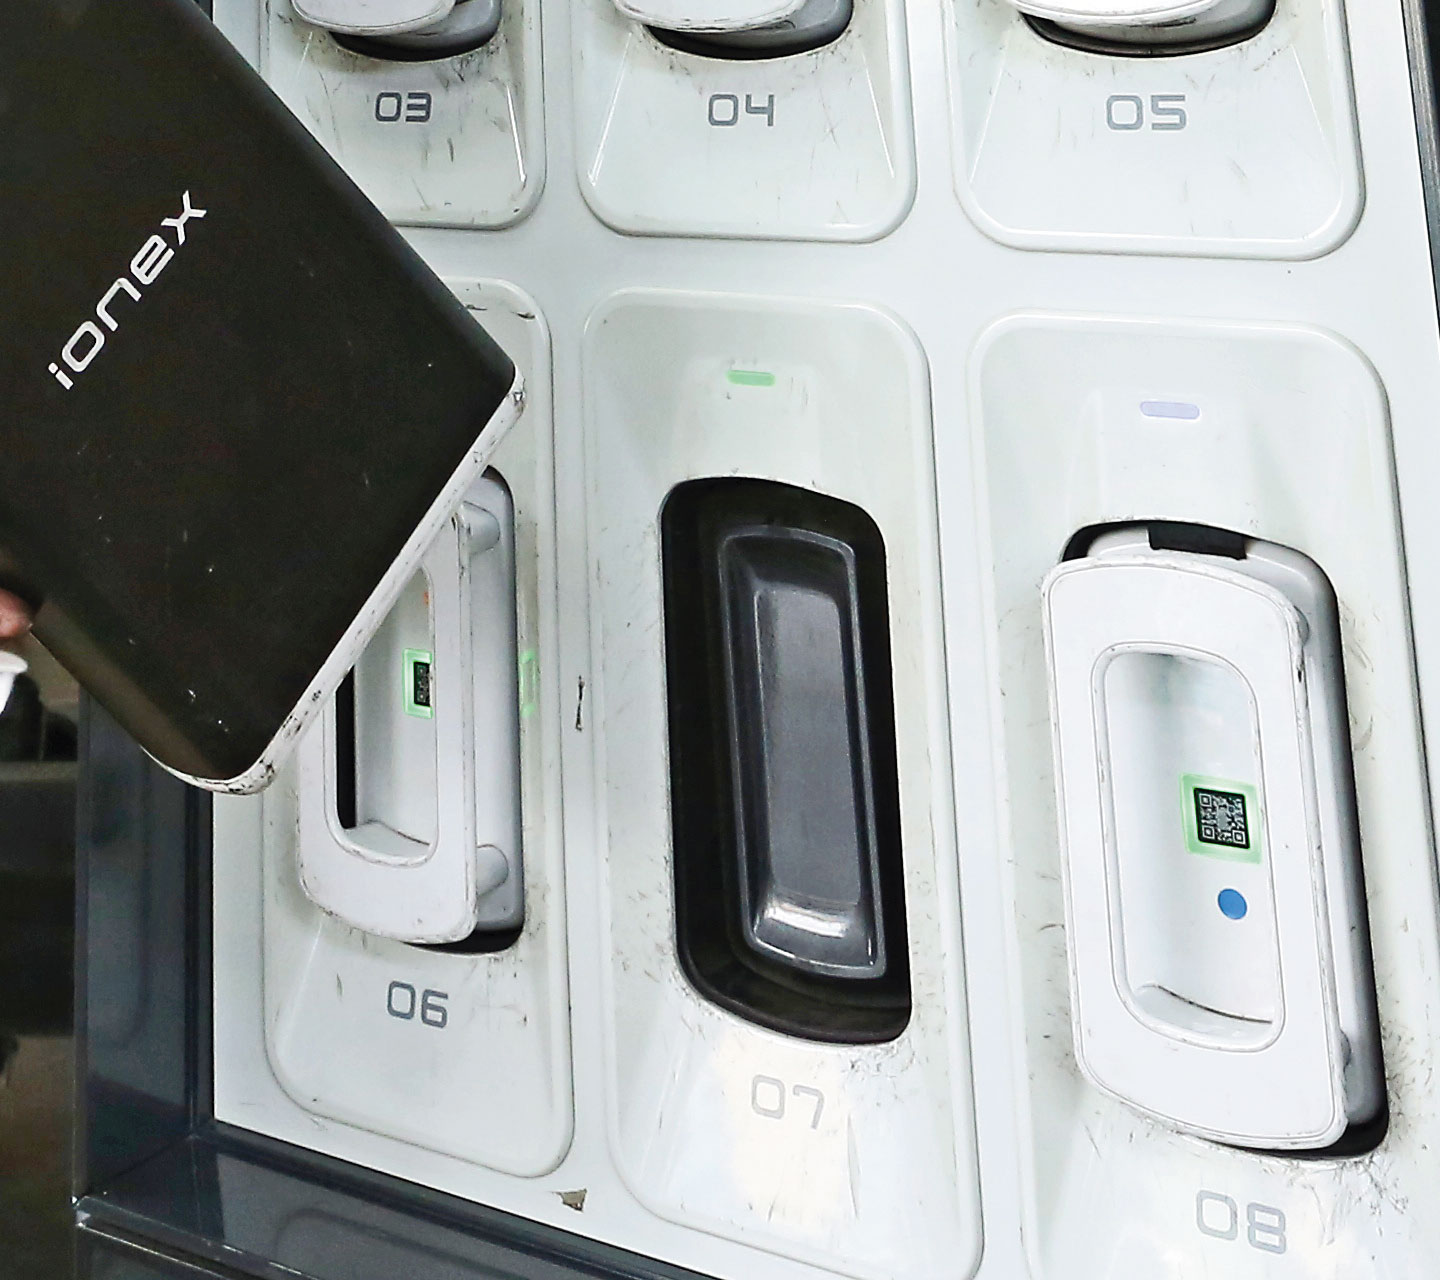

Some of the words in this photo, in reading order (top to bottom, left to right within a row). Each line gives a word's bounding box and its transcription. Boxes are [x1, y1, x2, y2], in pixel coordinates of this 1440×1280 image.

[374, 89, 431, 122] 03
[707, 93, 775, 127] 04
[1105, 93, 1186, 130] 05
[47, 190, 206, 390] ionex
[387, 983, 448, 1028] 06
[751, 1073, 824, 1129] 07
[1197, 1190, 1287, 1254] 08
